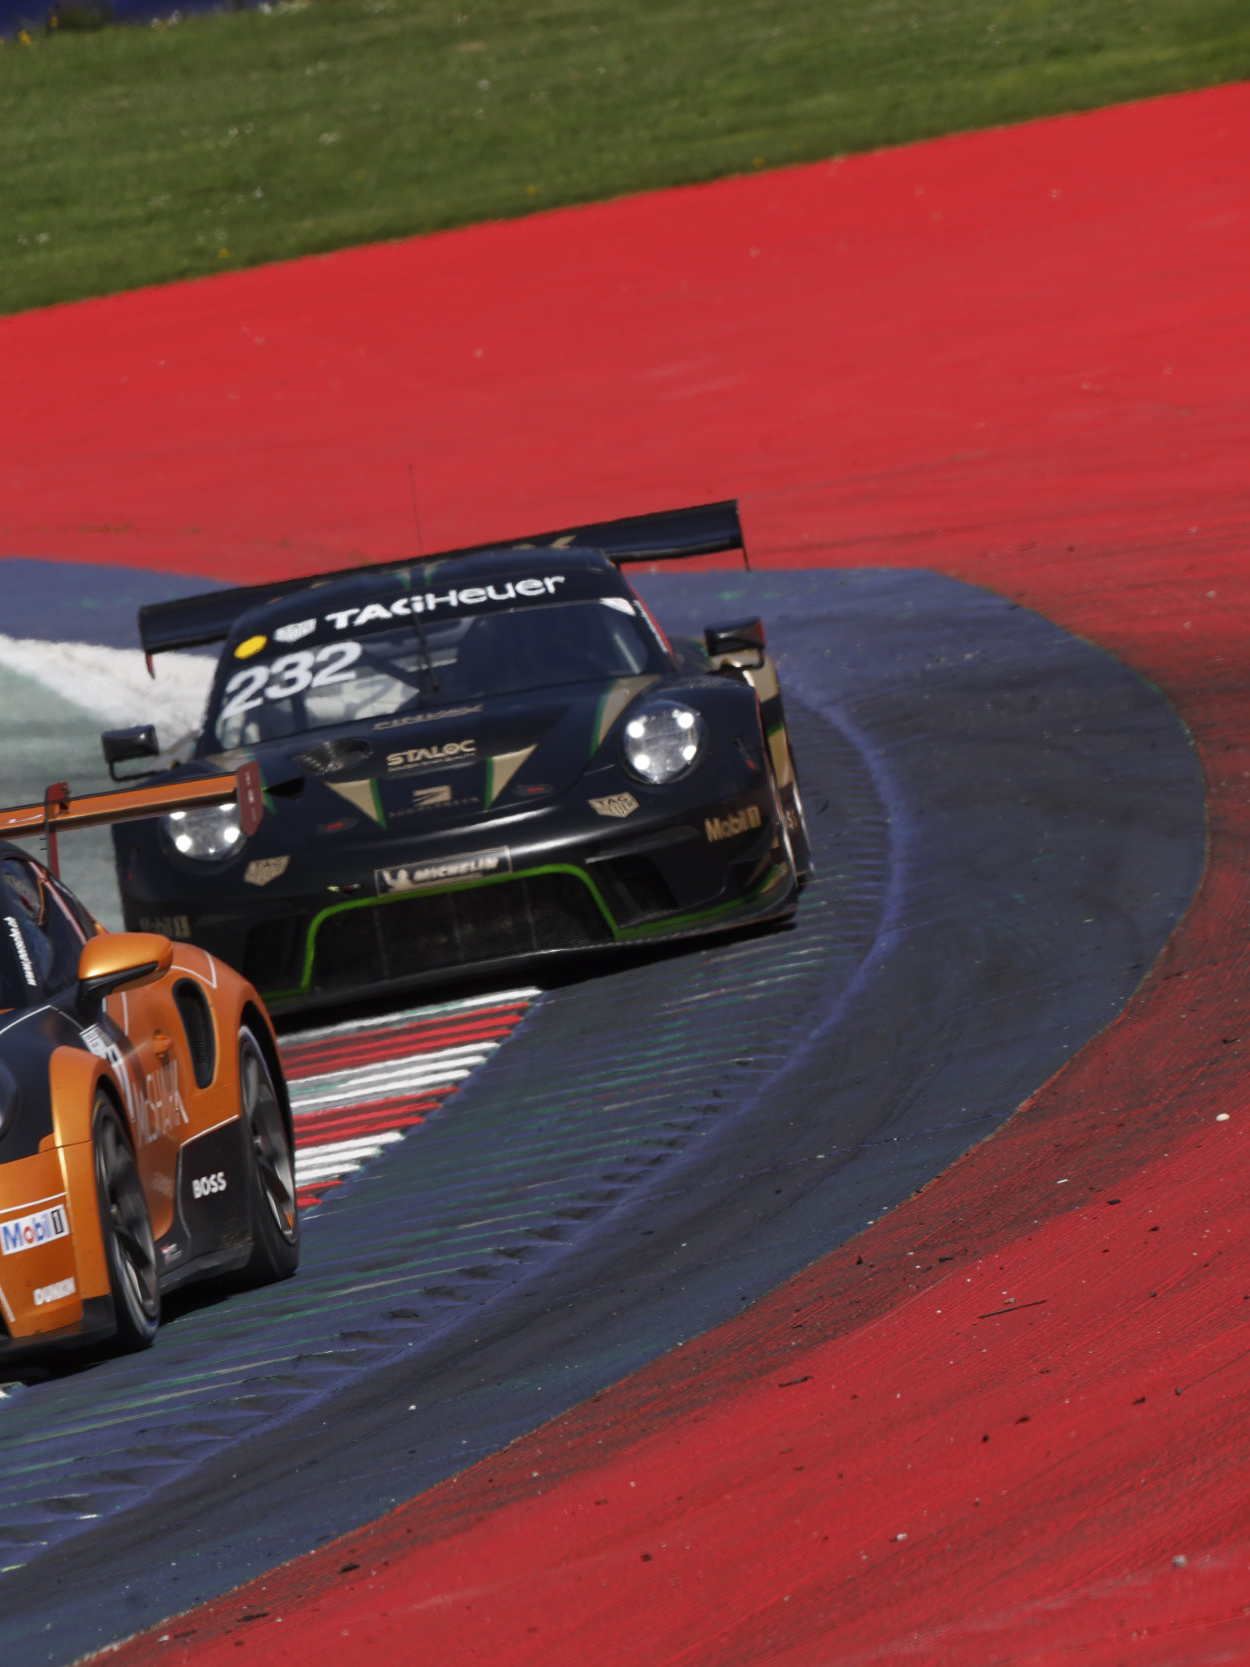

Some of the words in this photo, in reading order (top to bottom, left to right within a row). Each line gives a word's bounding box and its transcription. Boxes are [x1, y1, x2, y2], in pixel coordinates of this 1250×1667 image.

[220, 641, 364, 719] 232
[386, 738, 478, 766] STALOC
[704, 808, 749, 843] Mobil
[413, 855, 500, 882] MICHELIN
[192, 1171, 227, 1199] BOSS
[2, 1214, 51, 1251] Mobil
[50, 1208, 65, 1236] 1
